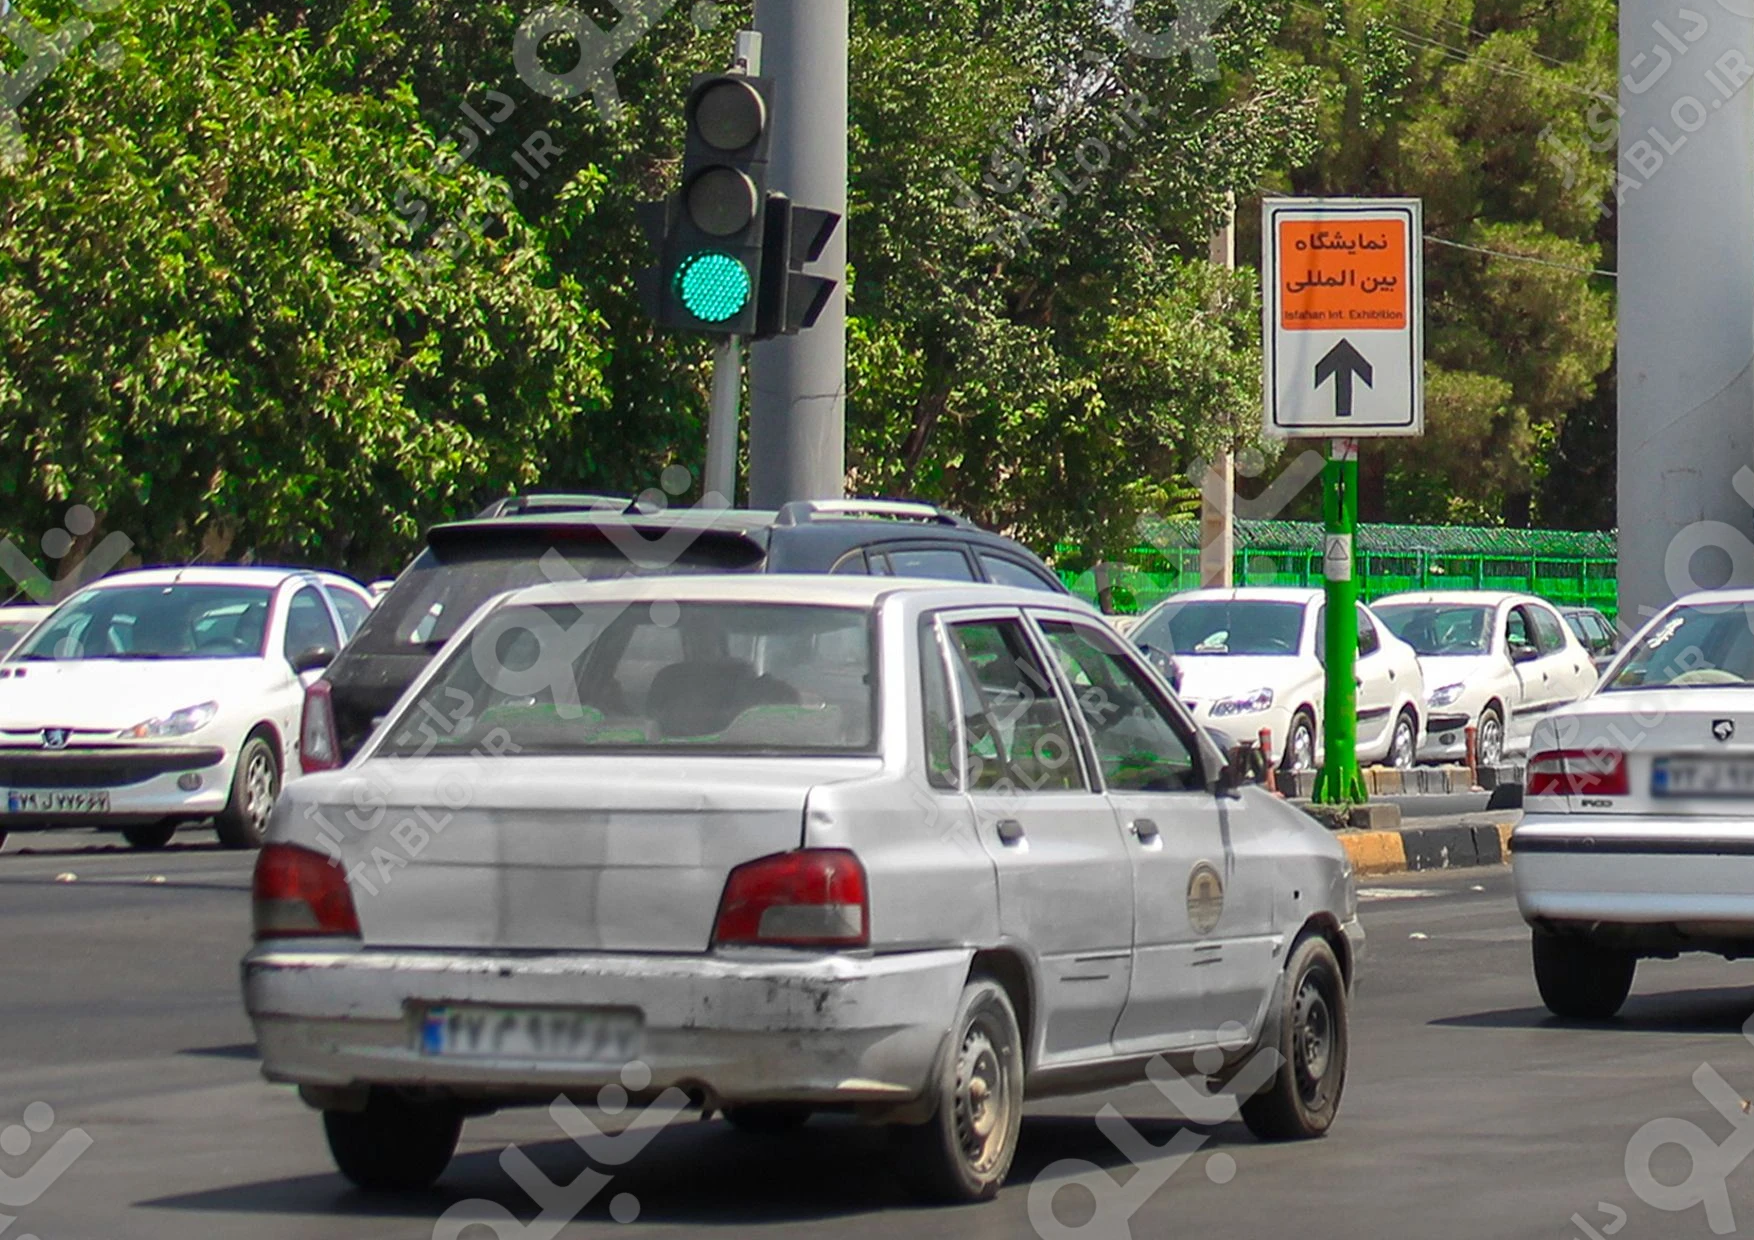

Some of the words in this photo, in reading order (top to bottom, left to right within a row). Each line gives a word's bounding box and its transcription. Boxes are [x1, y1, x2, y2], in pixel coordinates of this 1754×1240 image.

[1295, 231, 1388, 255] نمایشگاه
[1286, 269, 1355, 294] المللی
[1360, 275, 1398, 294] بین
[1348, 308, 1403, 320] Exhibition
